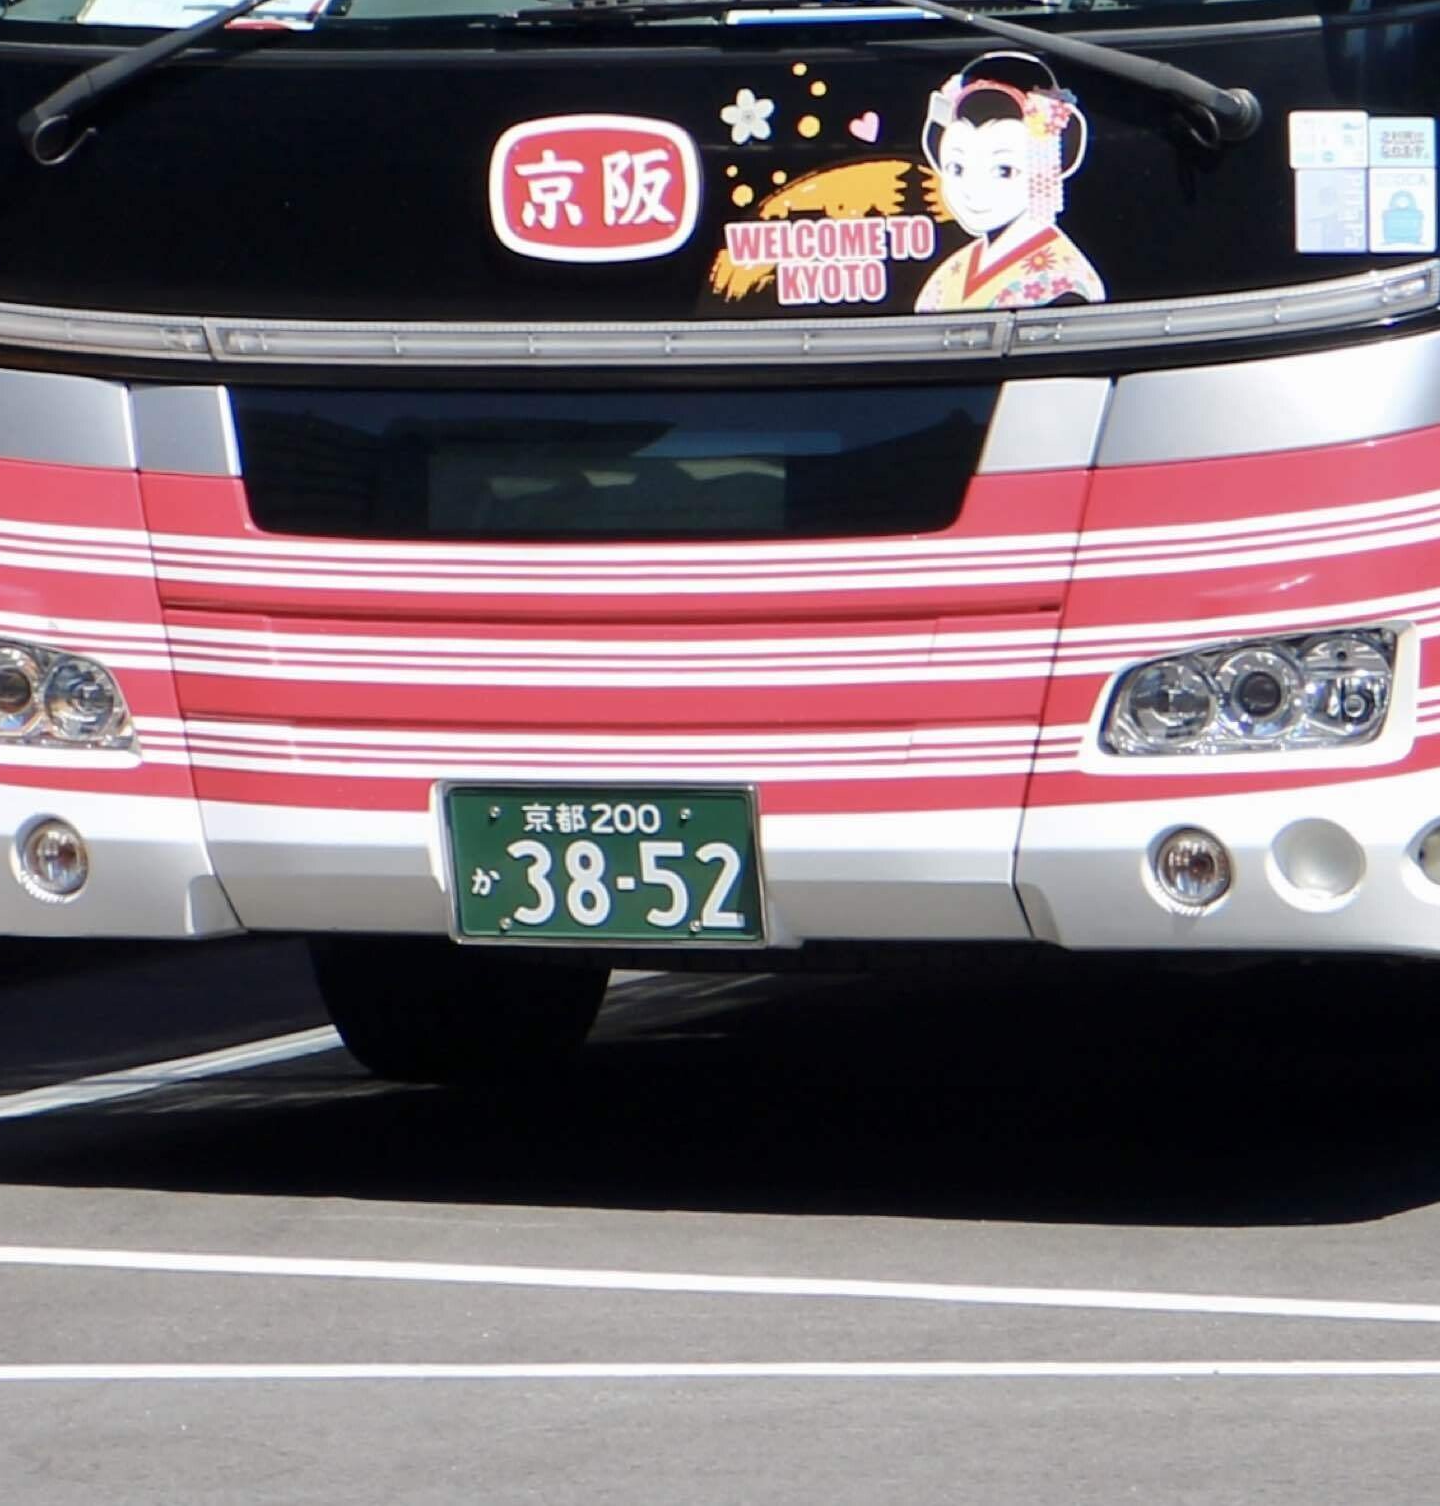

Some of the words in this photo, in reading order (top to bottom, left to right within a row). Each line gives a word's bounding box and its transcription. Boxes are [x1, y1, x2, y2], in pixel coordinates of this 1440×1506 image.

[515, 147, 676, 229] 京阪
[727, 220, 885, 261] WELCOME
[886, 216, 933, 258] TO
[780, 262, 885, 301] KYOTO
[471, 867, 501, 896] か
[506, 839, 746, 928] 38-52
